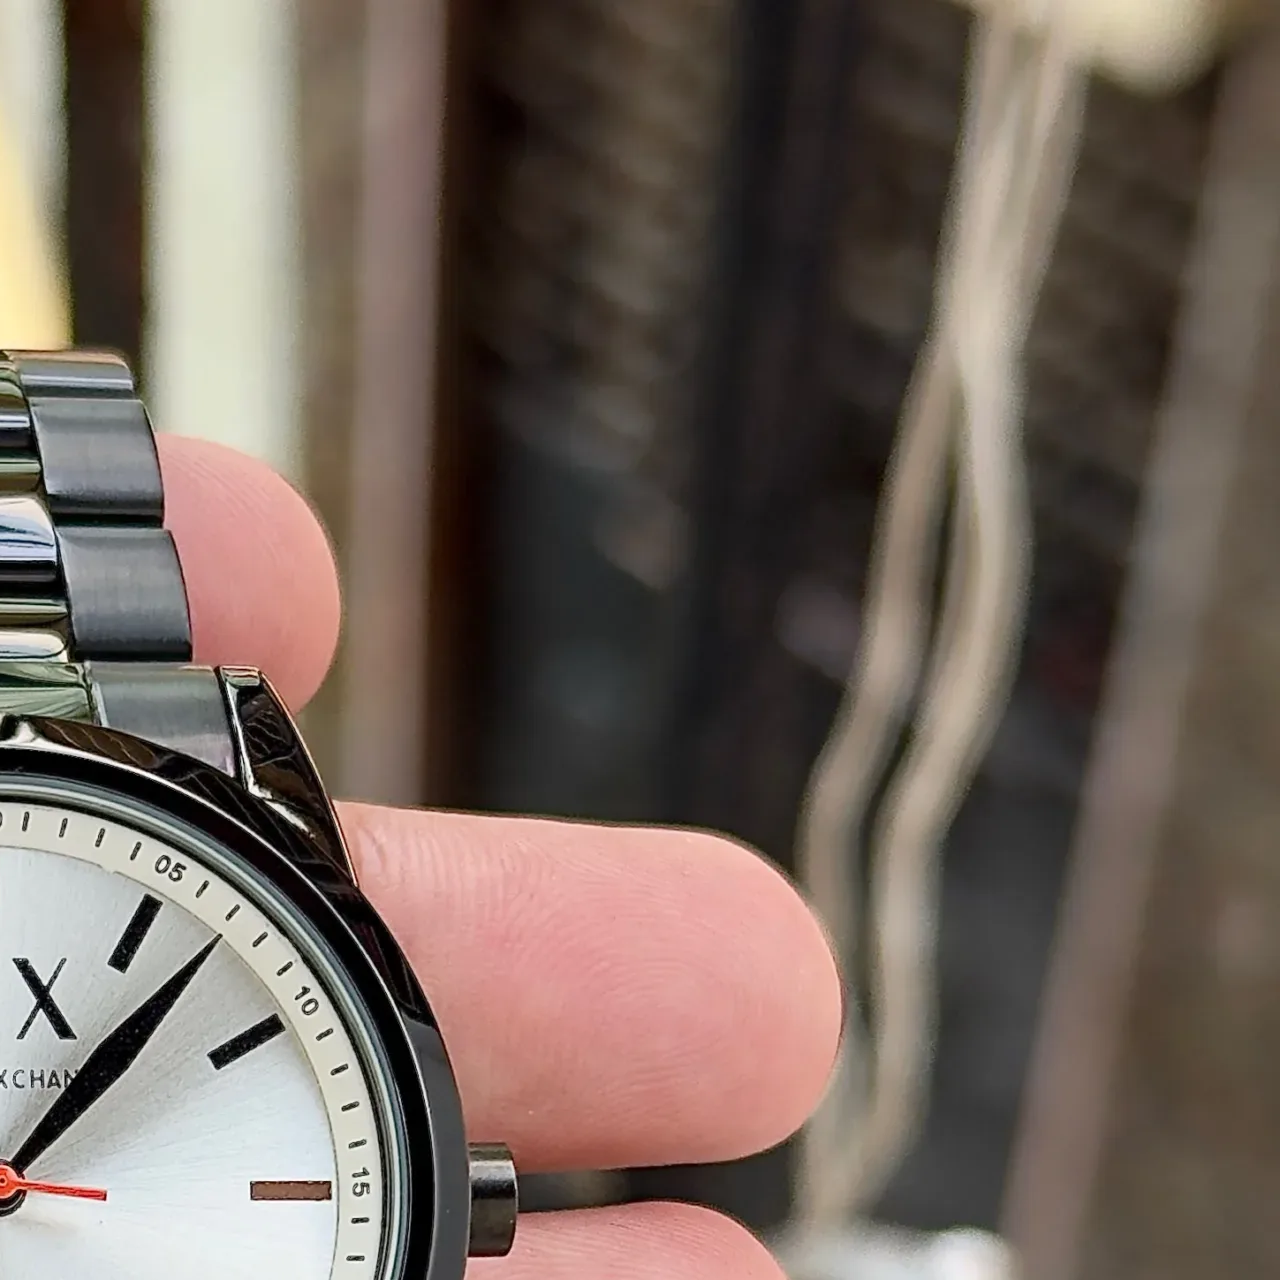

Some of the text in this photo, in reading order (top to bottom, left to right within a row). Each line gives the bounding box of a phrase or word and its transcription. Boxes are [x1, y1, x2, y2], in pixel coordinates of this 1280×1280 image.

[154, 854, 187, 882] 05
[294, 985, 320, 1016] 10
[352, 1167, 370, 1197] 15
